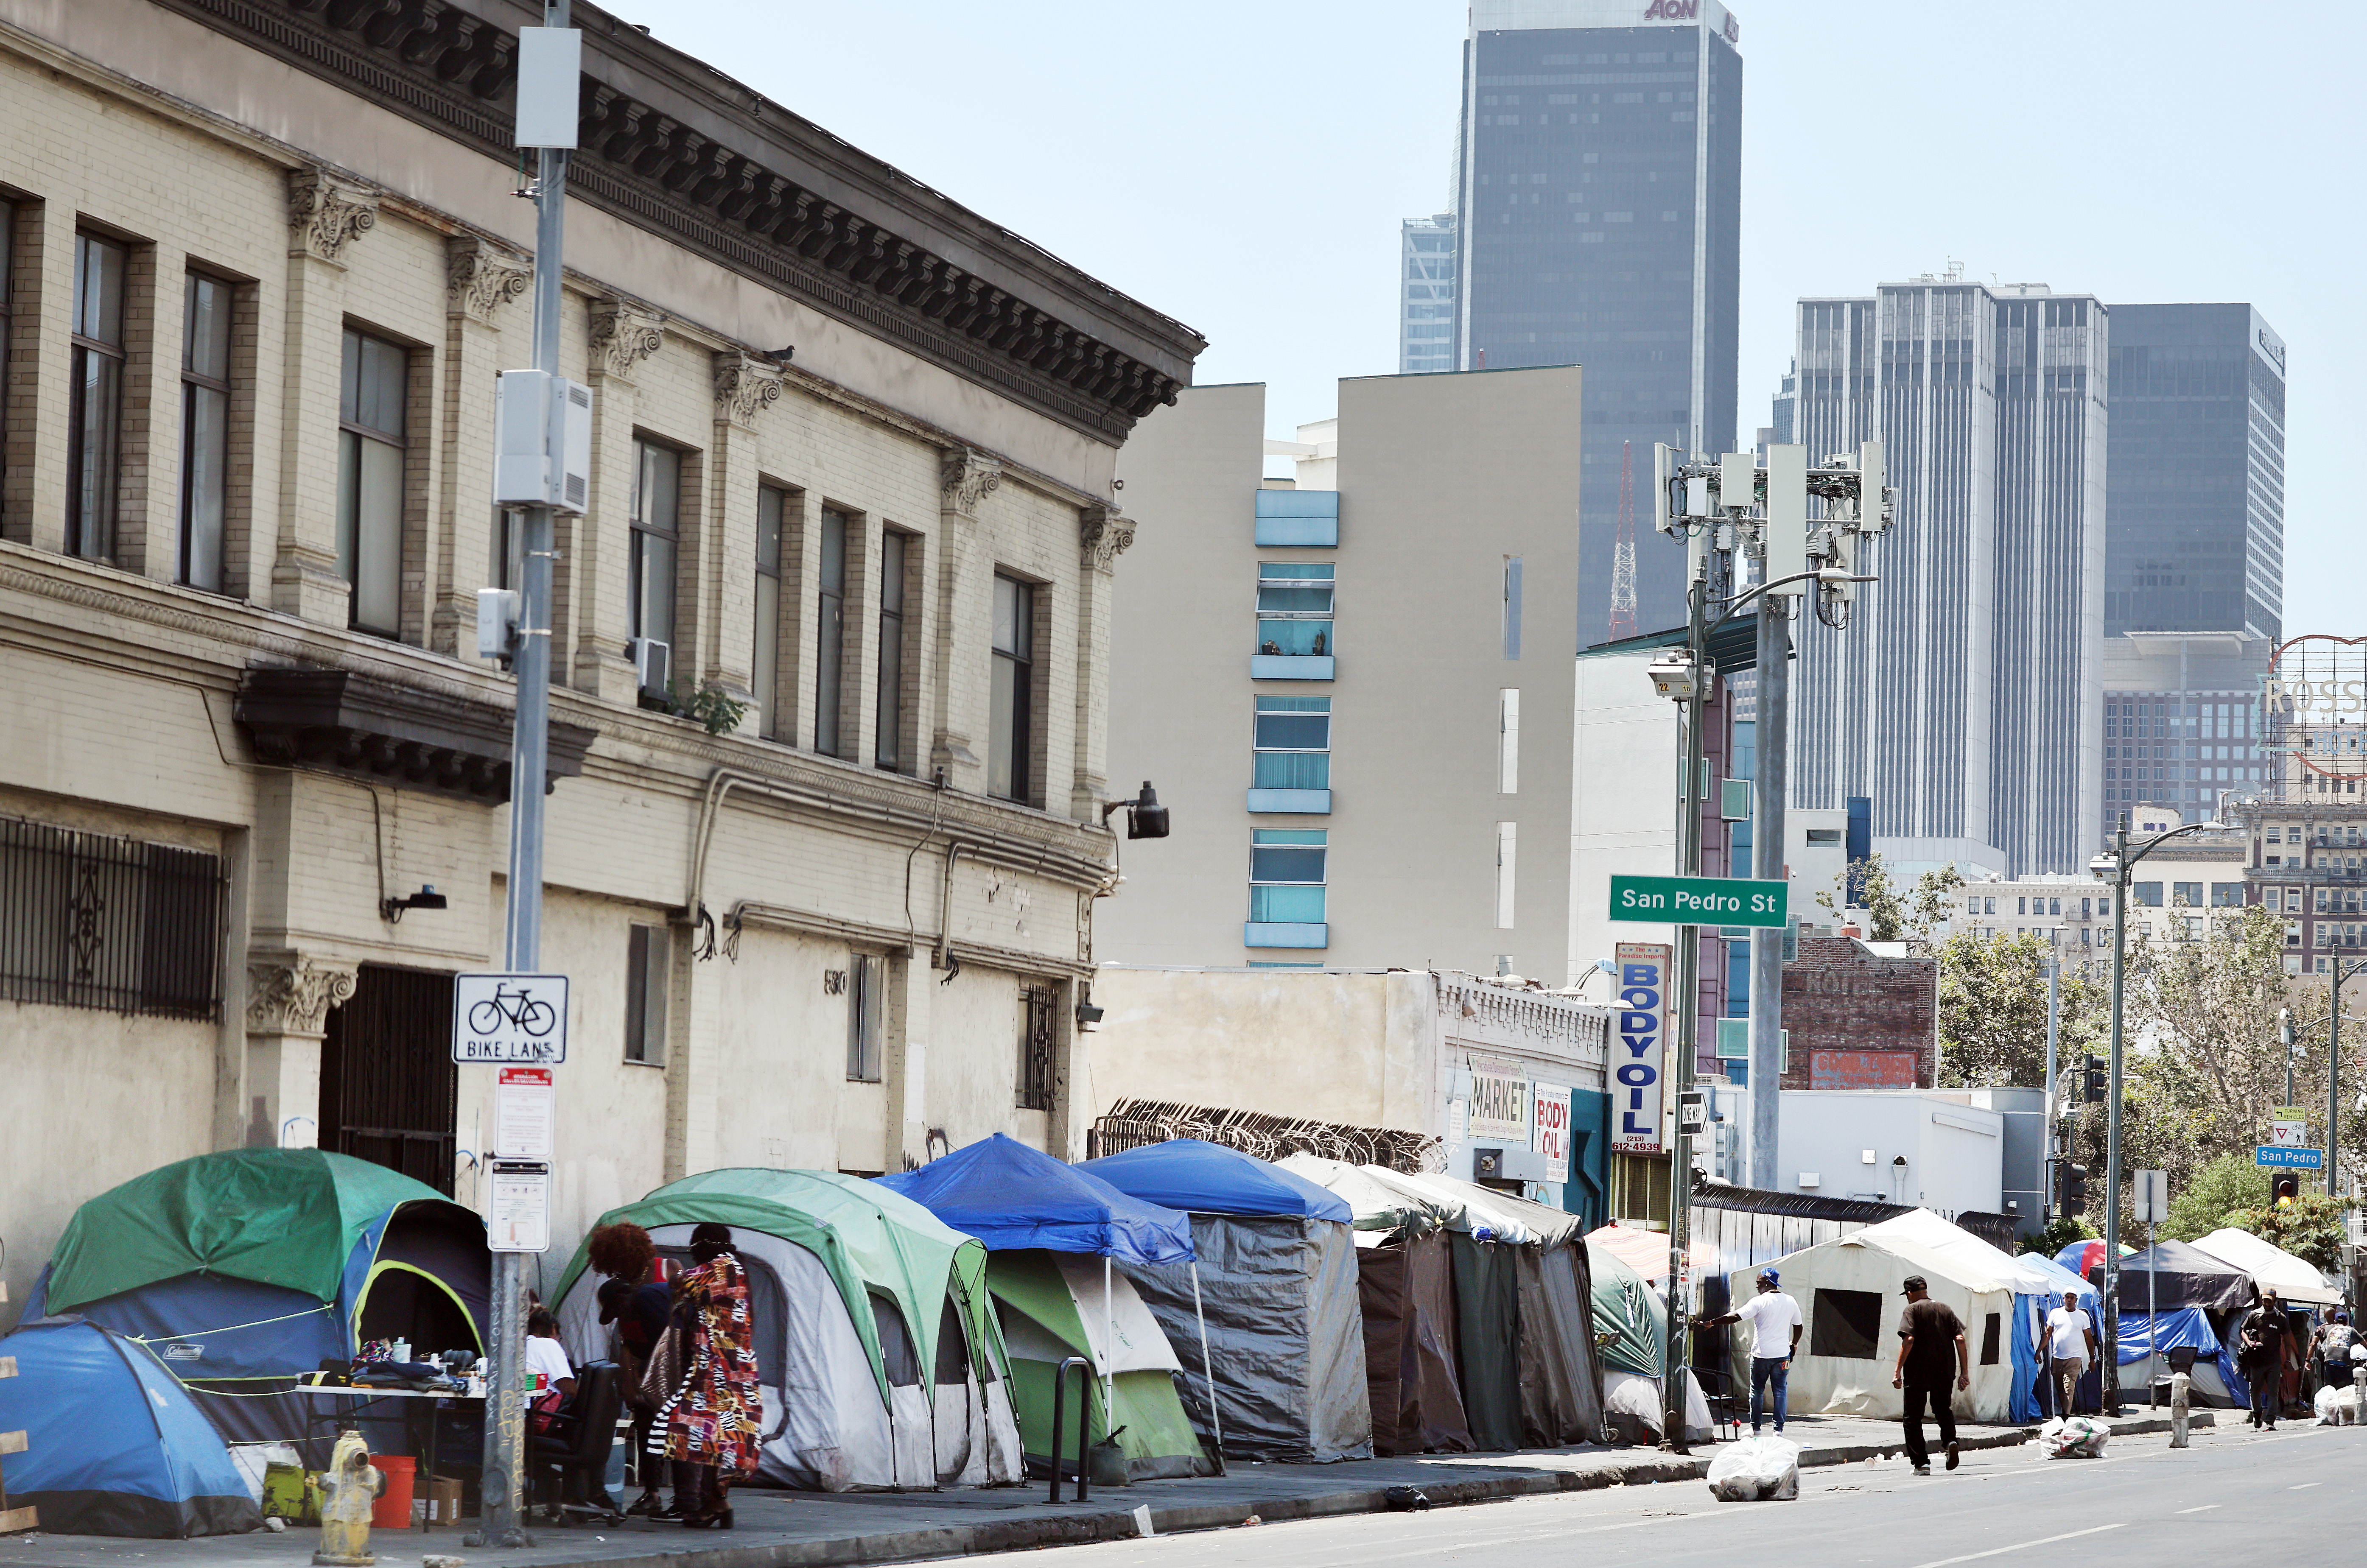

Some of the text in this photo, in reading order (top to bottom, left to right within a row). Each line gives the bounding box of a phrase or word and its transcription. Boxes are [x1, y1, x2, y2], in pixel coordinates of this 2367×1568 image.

[1644, 0, 1698, 19] AON
[1659, 683, 1669, 691] 22
[2266, 679, 2361, 713] ROSS
[1622, 889, 1776, 913] San Pedro St
[467, 1041, 503, 1057] BIKE
[1472, 1076, 1526, 1122] MARKET
[1537, 1099, 1567, 1130] BODY
[1683, 1107, 1691, 1121] ONE
[1543, 1131, 1560, 1158] OIL
[1612, 1142, 1659, 1151] 612-4939
[2261, 1150, 2317, 1163] San Pedro
